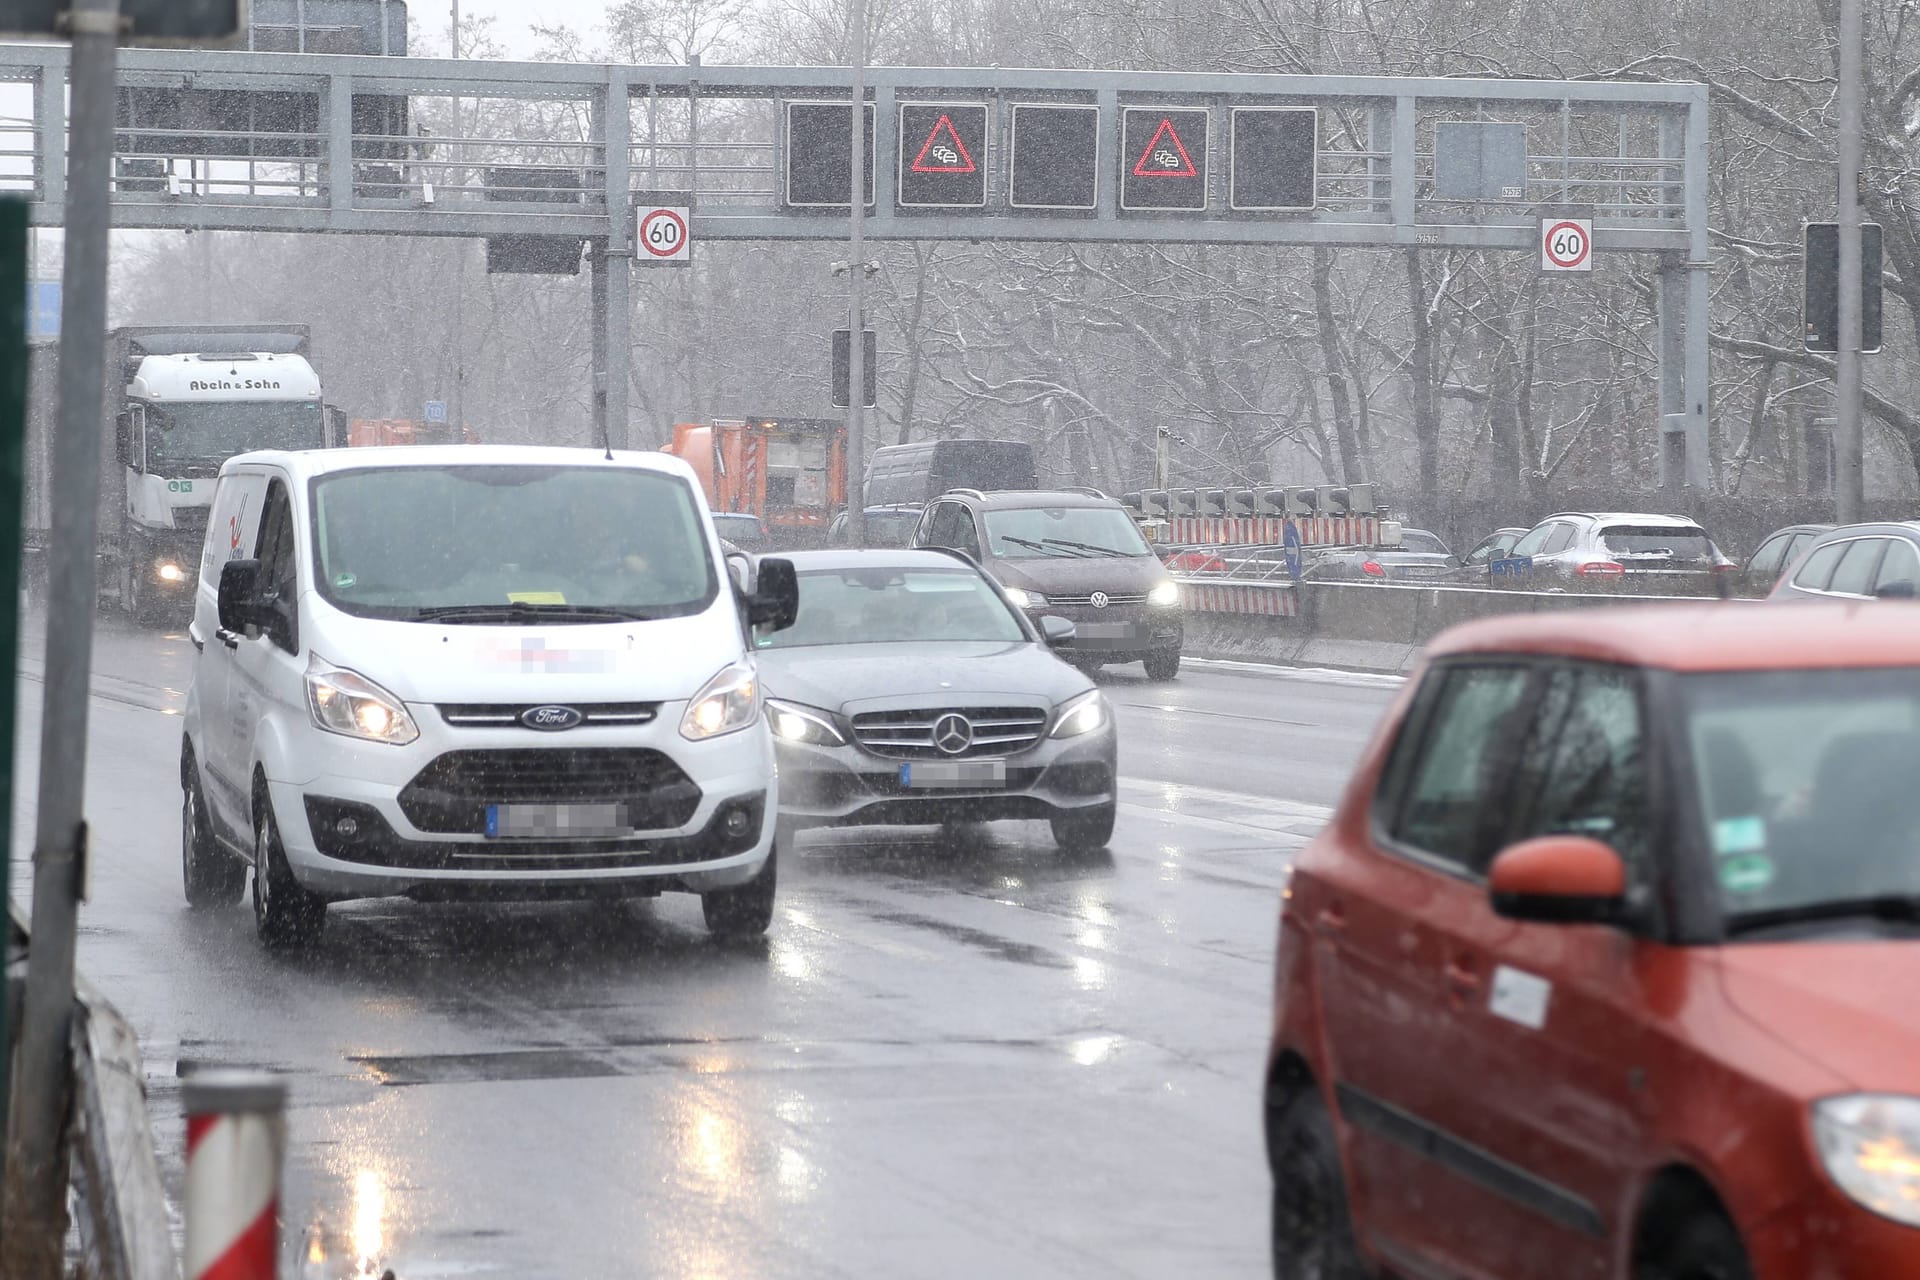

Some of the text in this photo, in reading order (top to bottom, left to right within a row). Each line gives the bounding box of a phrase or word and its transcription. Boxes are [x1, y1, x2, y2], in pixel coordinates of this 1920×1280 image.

[650, 222, 676, 243] 60
[1555, 234, 1579, 255] 60
[245, 379, 281, 389] Sohn
[535, 708, 568, 723] Ford
